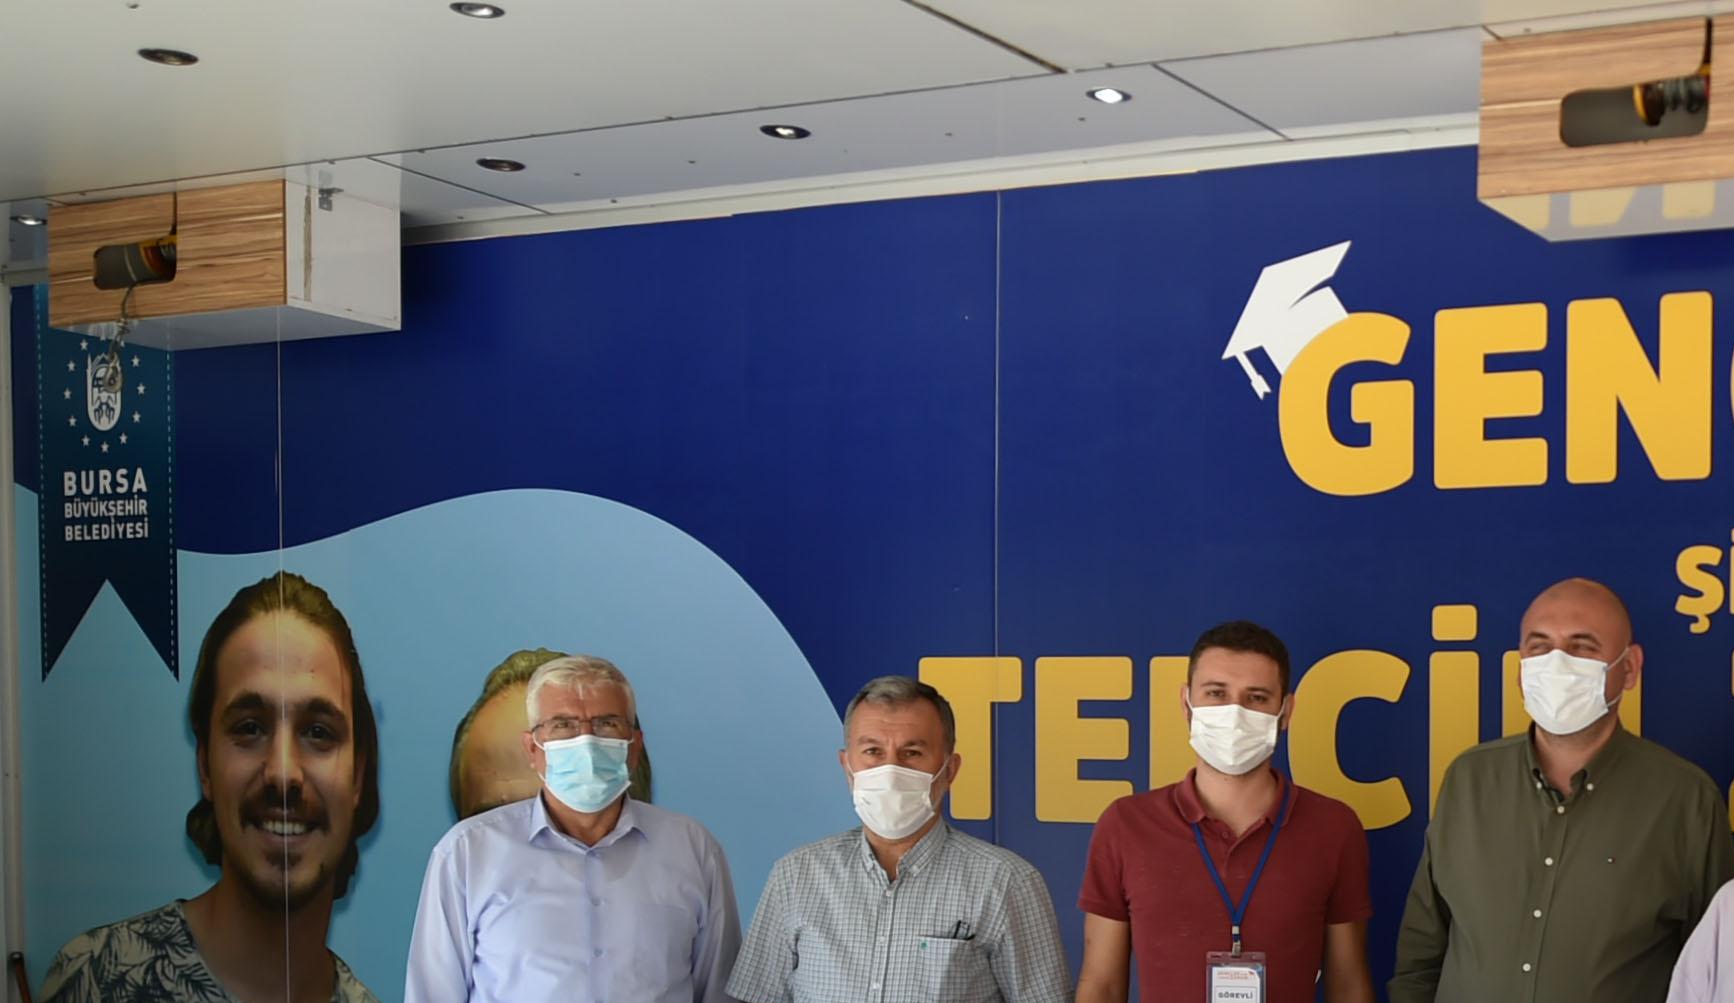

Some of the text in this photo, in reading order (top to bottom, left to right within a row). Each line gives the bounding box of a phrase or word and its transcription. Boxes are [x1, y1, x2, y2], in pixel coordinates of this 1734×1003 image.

[64, 467, 148, 496] BURSA
[64, 494, 148, 519] BÜYÜKŞEHİR
[64, 517, 149, 541] BELEDİYESİ
